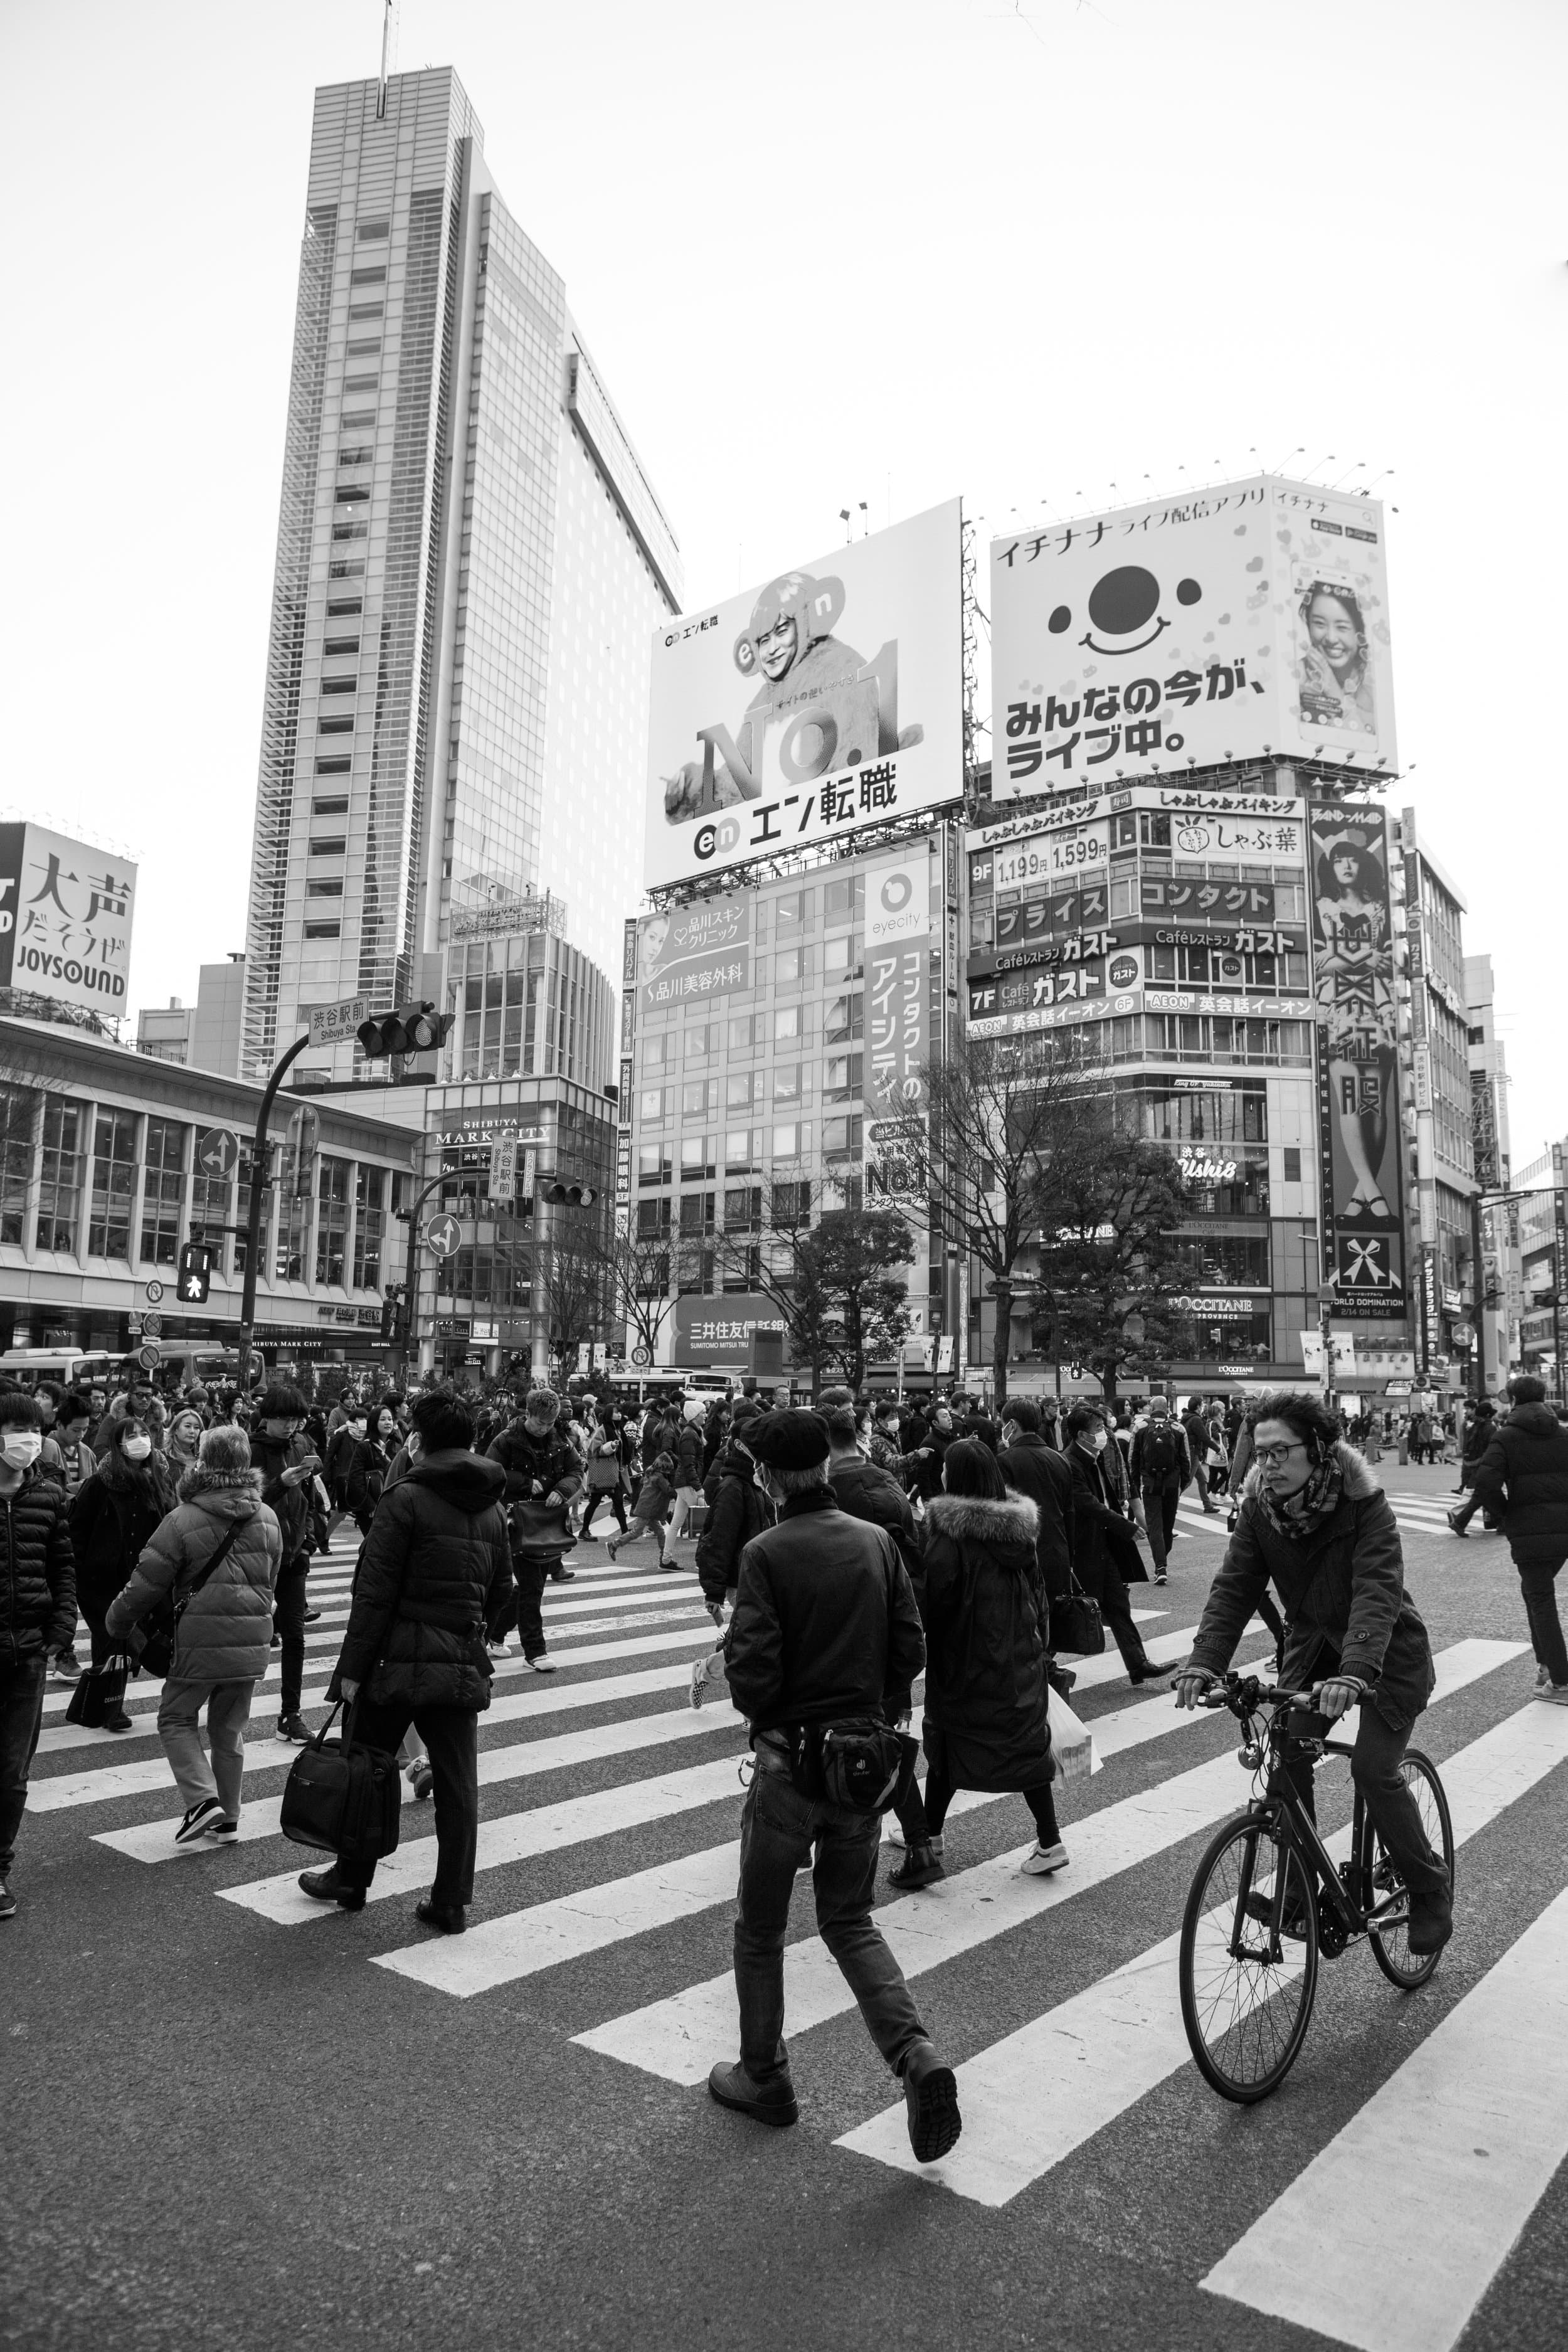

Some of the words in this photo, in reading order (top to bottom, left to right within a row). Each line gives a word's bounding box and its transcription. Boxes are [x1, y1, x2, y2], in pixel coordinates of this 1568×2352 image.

[1120, 487, 1266, 536] ライブ配信アプリ
[1278, 493, 1328, 512] イチナナ
[997, 521, 1113, 567] イチナナ
[1006, 657, 1265, 737] みんなの今が、
[1007, 719, 1184, 779] ライブ中。
[750, 761, 898, 845] エン転職
[1160, 792, 1297, 813] しゃぶしゃぶバイキング
[982, 801, 1099, 843] しゃぶしゃぶバイキング
[1310, 808, 1384, 824] BAND-MAID
[1218, 824, 1297, 852] しゃぶ葉
[973, 863, 992, 882] 9F
[24, 852, 132, 923] 大声
[1142, 882, 1269, 912] コンタクト
[689, 906, 744, 933] 品川スキン
[872, 913, 921, 936] eyecity
[998, 891, 1104, 936] プライス
[21, 909, 126, 972] だそうぜ。
[689, 924, 738, 949] クリニック
[1063, 932, 1117, 961] ガスト
[1234, 929, 1295, 954] ガスト
[17, 945, 125, 997] JOYSOUND
[656, 963, 743, 1002] 品川美容外科
[1113, 970, 1136, 981] ガスト
[972, 989, 995, 1010] 7F
[1000, 982, 1029, 999] Café
[1032, 968, 1099, 1007] ガスト
[1012, 1002, 1110, 1030] 英会話イーオン
[1117, 999, 1131, 1010] 6F
[1152, 994, 1189, 1009] AEON
[1199, 995, 1311, 1015] 英会話イーオン
[314, 1001, 364, 1030] 渋谷駅前
[903, 951, 921, 1101] コンタクトの
[972, 1020, 1002, 1035] AEON
[320, 1027, 344, 1042] Shibuya
[346, 1024, 358, 1034] Sta.
[872, 956, 898, 1104] アイシティ
[435, 1130, 492, 1145] MARK
[502, 1127, 549, 1139] CITY
[463, 1119, 517, 1129] SHIBUYA
[492, 1148, 501, 1173] Shibuya
[617, 1138, 629, 1190] 加藤眼科
[1182, 1146, 1205, 1158] 渋谷
[499, 1142, 513, 1194] 渋谷駅前
[1177, 1158, 1237, 1179] Ushi8
[1169, 1295, 1253, 1312] L'OCCITANE
[1357, 1298, 1404, 1306] DOMINATION
[1218, 1364, 1254, 1373] L'OCCITANE
